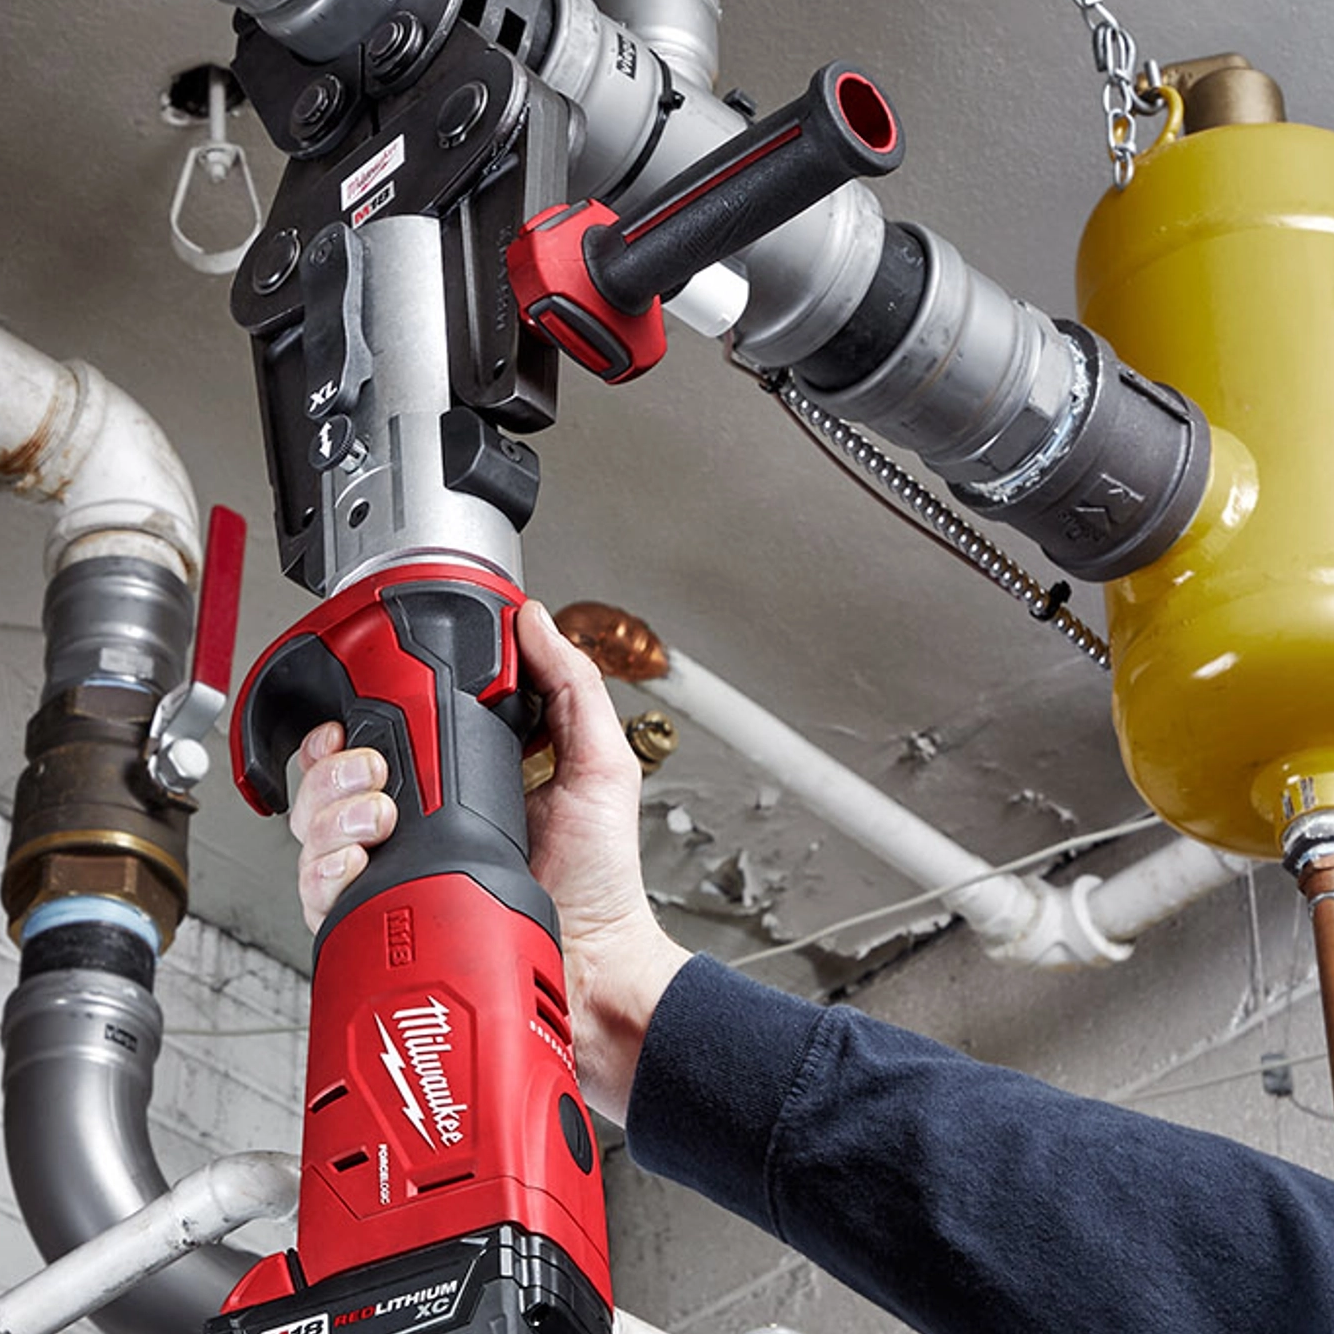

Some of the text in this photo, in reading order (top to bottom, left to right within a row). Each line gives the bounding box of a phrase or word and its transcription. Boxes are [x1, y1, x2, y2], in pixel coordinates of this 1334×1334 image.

[309, 379, 338, 413] XL
[392, 995, 468, 1147] Milwaukee
[333, 1280, 458, 1329] REDLITHIUM
[414, 1297, 451, 1320] XC
